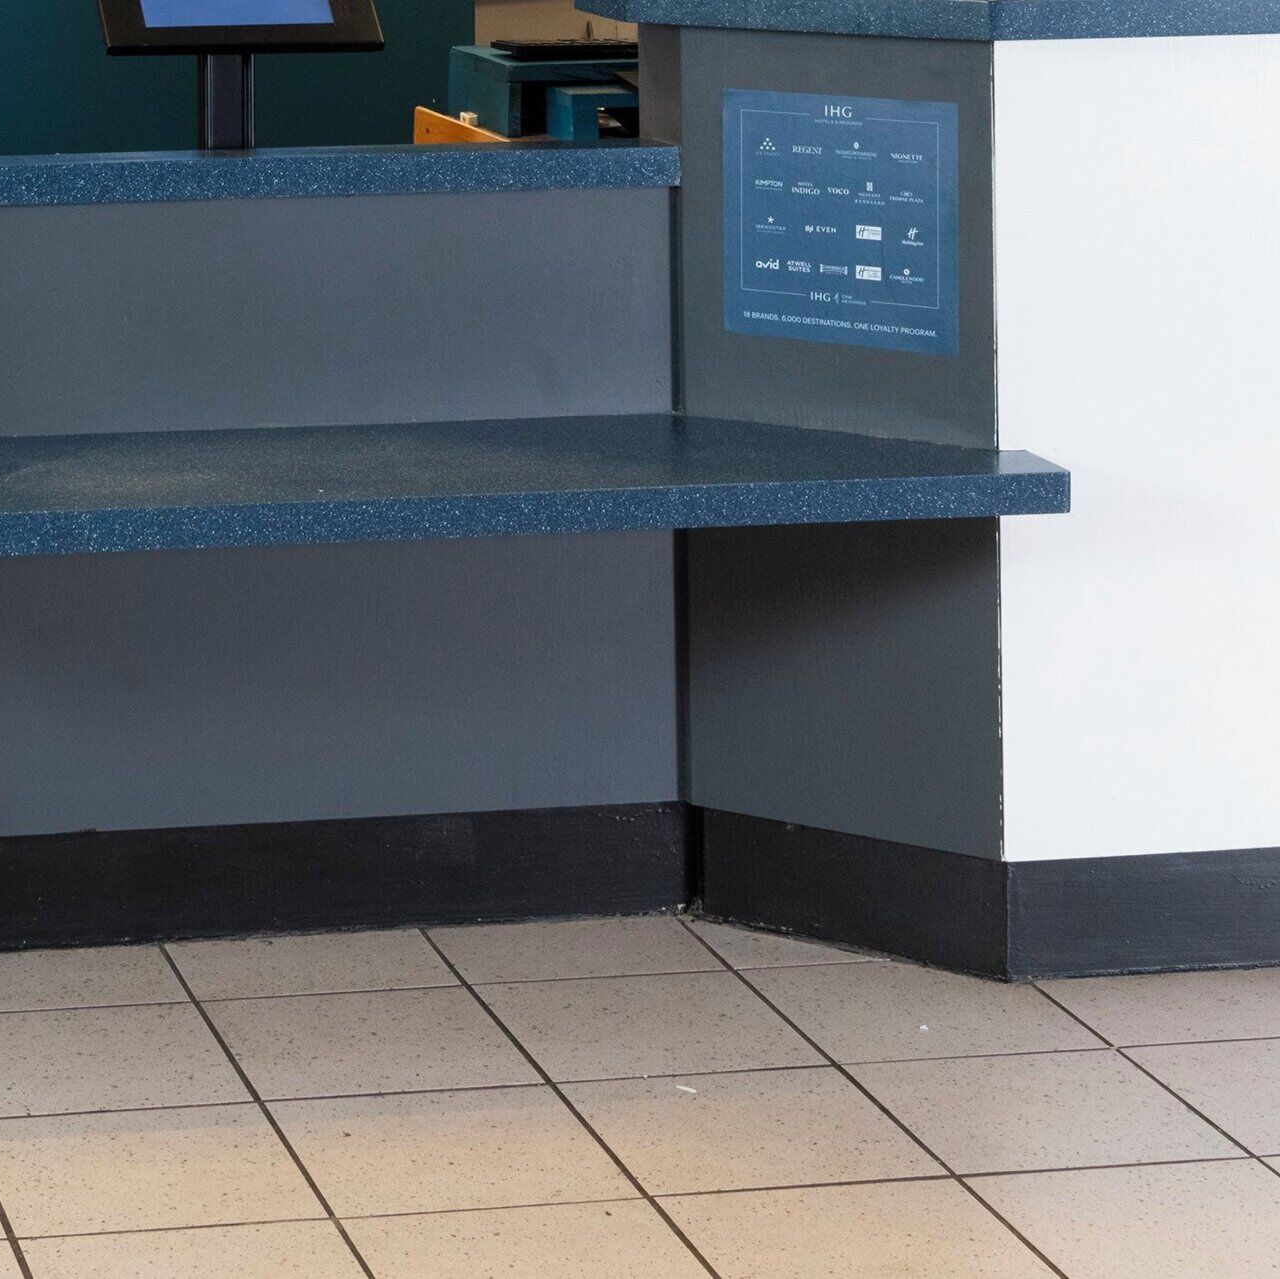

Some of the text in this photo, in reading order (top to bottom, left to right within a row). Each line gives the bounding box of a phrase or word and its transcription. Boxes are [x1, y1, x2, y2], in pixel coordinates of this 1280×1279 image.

[824, 104, 852, 118] IHG
[792, 145, 822, 155] REGENT
[891, 153, 922, 161] VIGNETTE
[755, 179, 783, 187] KIMPTON
[792, 186, 820, 195] INDIGO
[816, 226, 836, 234] EVEN
[756, 258, 779, 270] avid
[890, 274, 924, 282] CANDLEWOOD
[810, 292, 831, 302] IHG
[752, 312, 780, 321] BRANDS.
[782, 314, 801, 324] 6,000
[802, 316, 852, 329] DESTINATIONS.
[854, 322, 869, 330] ONE
[870, 324, 899, 334] LOYALTY
[900, 327, 937, 337] PROGRAM.
